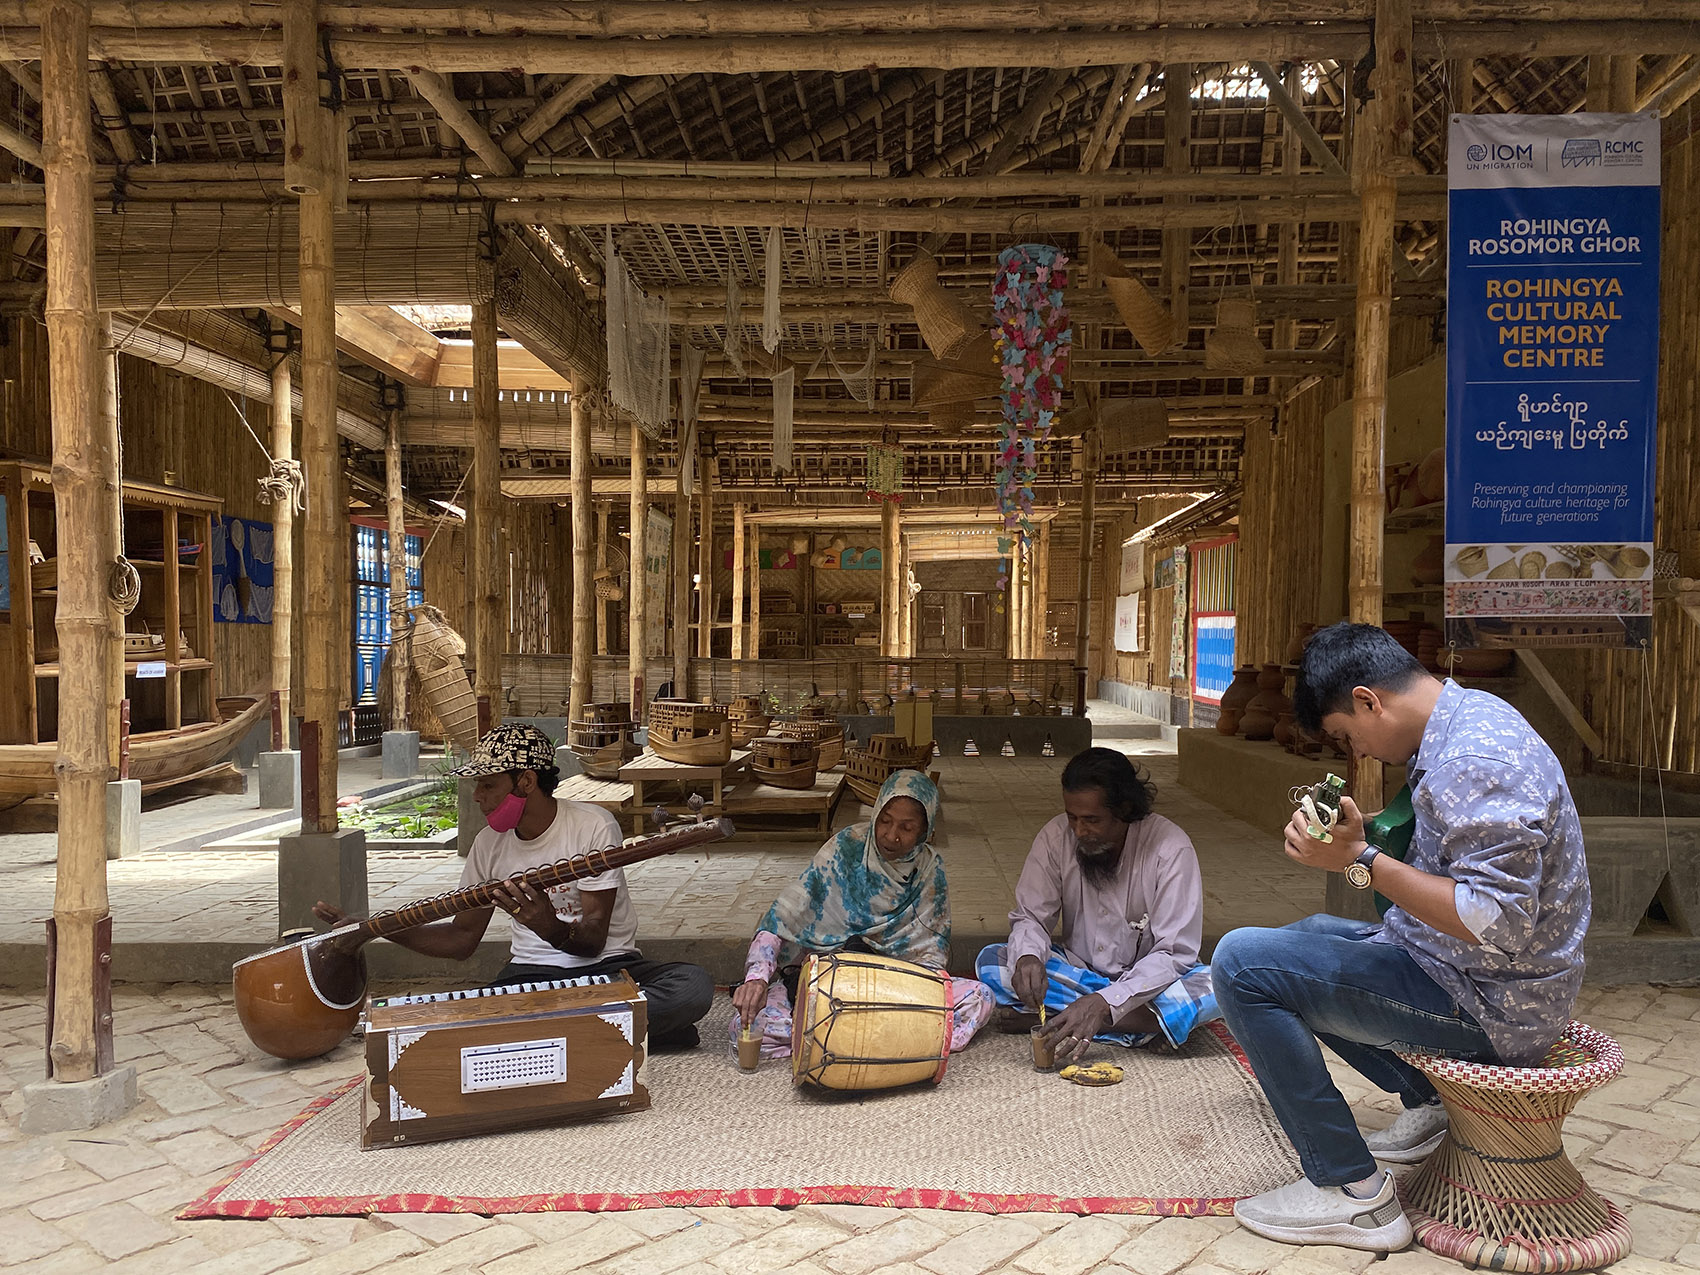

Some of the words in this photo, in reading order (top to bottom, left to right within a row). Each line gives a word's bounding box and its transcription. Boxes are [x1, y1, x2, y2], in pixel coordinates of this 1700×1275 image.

[1491, 143, 1533, 161] IOM
[1604, 141, 1644, 154] RCMC
[1466, 163, 1480, 171] UN
[1483, 162, 1534, 171] MIGRATION
[1500, 218, 1612, 236] ROHINGYA
[1469, 238, 1575, 255] ROSOMOR
[1580, 236, 1641, 253] GHOR
[1486, 277, 1624, 298] ROHINGYA
[1486, 302, 1622, 322] CULTURAL
[1499, 324, 1610, 345] MEMORY
[1503, 348, 1604, 368] CENTRE
[1473, 482, 1530, 497] Preserving
[1532, 482, 1554, 494] and
[1557, 482, 1628, 497] championing
[1471, 496, 1522, 511] Rohingya
[1525, 496, 1562, 508] culture
[1565, 496, 1610, 510] heritage
[1613, 495, 1630, 510] for
[1500, 510, 1533, 524] future
[1536, 511, 1599, 525] generations
